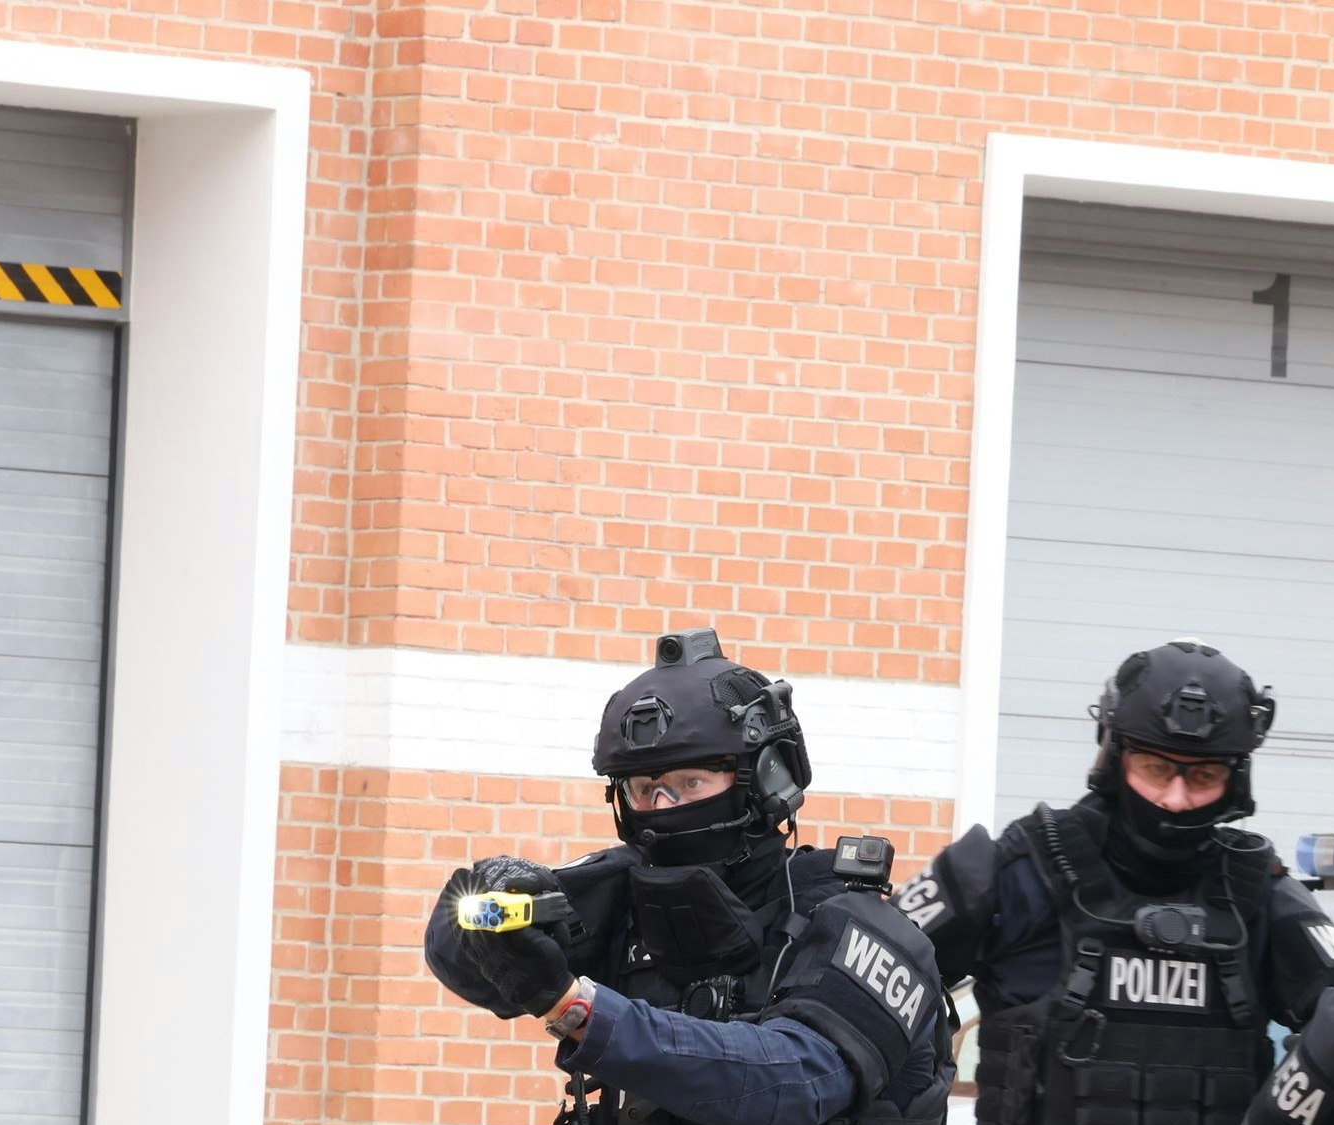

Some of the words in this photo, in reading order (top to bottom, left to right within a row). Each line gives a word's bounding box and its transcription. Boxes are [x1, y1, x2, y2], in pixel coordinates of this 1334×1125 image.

[1252, 271, 1291, 378] 1
[844, 928, 925, 1030] WEGA
[1109, 956, 1207, 1008] POLIZEI
